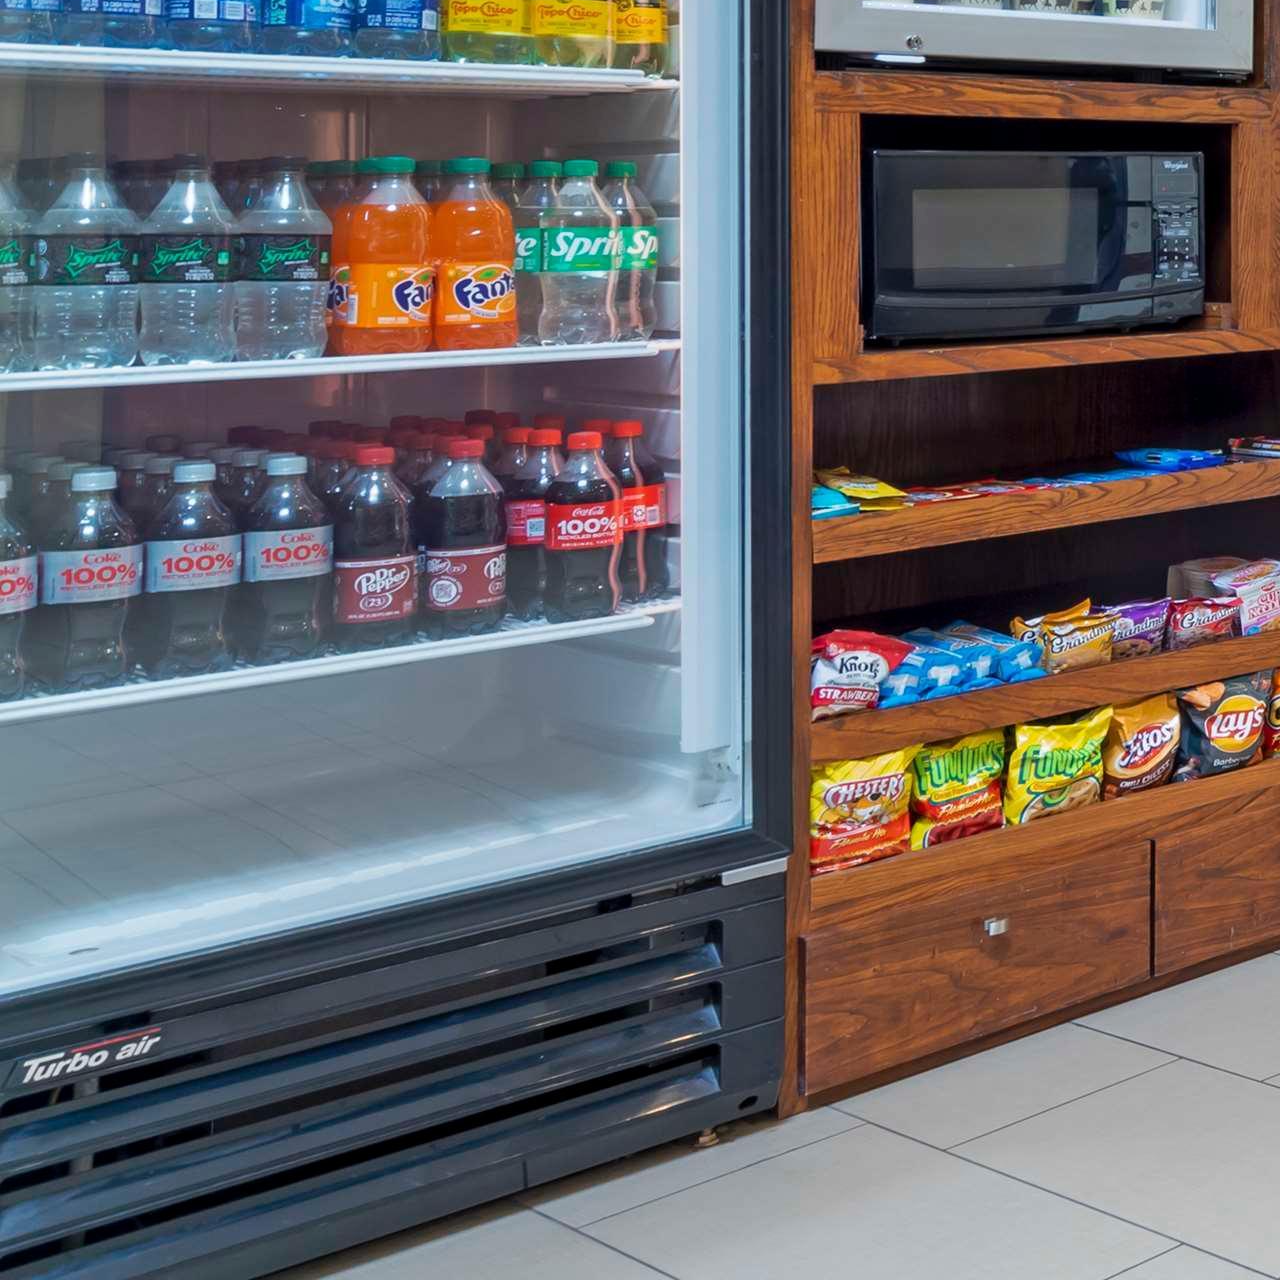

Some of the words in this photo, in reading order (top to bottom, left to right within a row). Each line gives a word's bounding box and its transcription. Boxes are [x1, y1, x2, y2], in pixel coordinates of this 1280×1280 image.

[69, 248, 122, 267] Sprite
[156, 247, 204, 266] Sprite
[262, 248, 310, 265] Sprite
[454, 271, 515, 307] Fant
[556, 515, 618, 536] 100%
[281, 532, 315, 544] Coke
[183, 543, 220, 554] Coke
[261, 543, 329, 563] 100%
[83, 552, 121, 565] Coke
[162, 552, 234, 574] 100%
[60, 562, 137, 586] 100%
[360, 571, 407, 595] Pepper
[375, 568, 396, 581] Dr
[368, 597, 382, 607] 23
[1209, 704, 1267, 741] Lay's
[22, 1050, 109, 1084] Turbo
[115, 1035, 161, 1061] air
